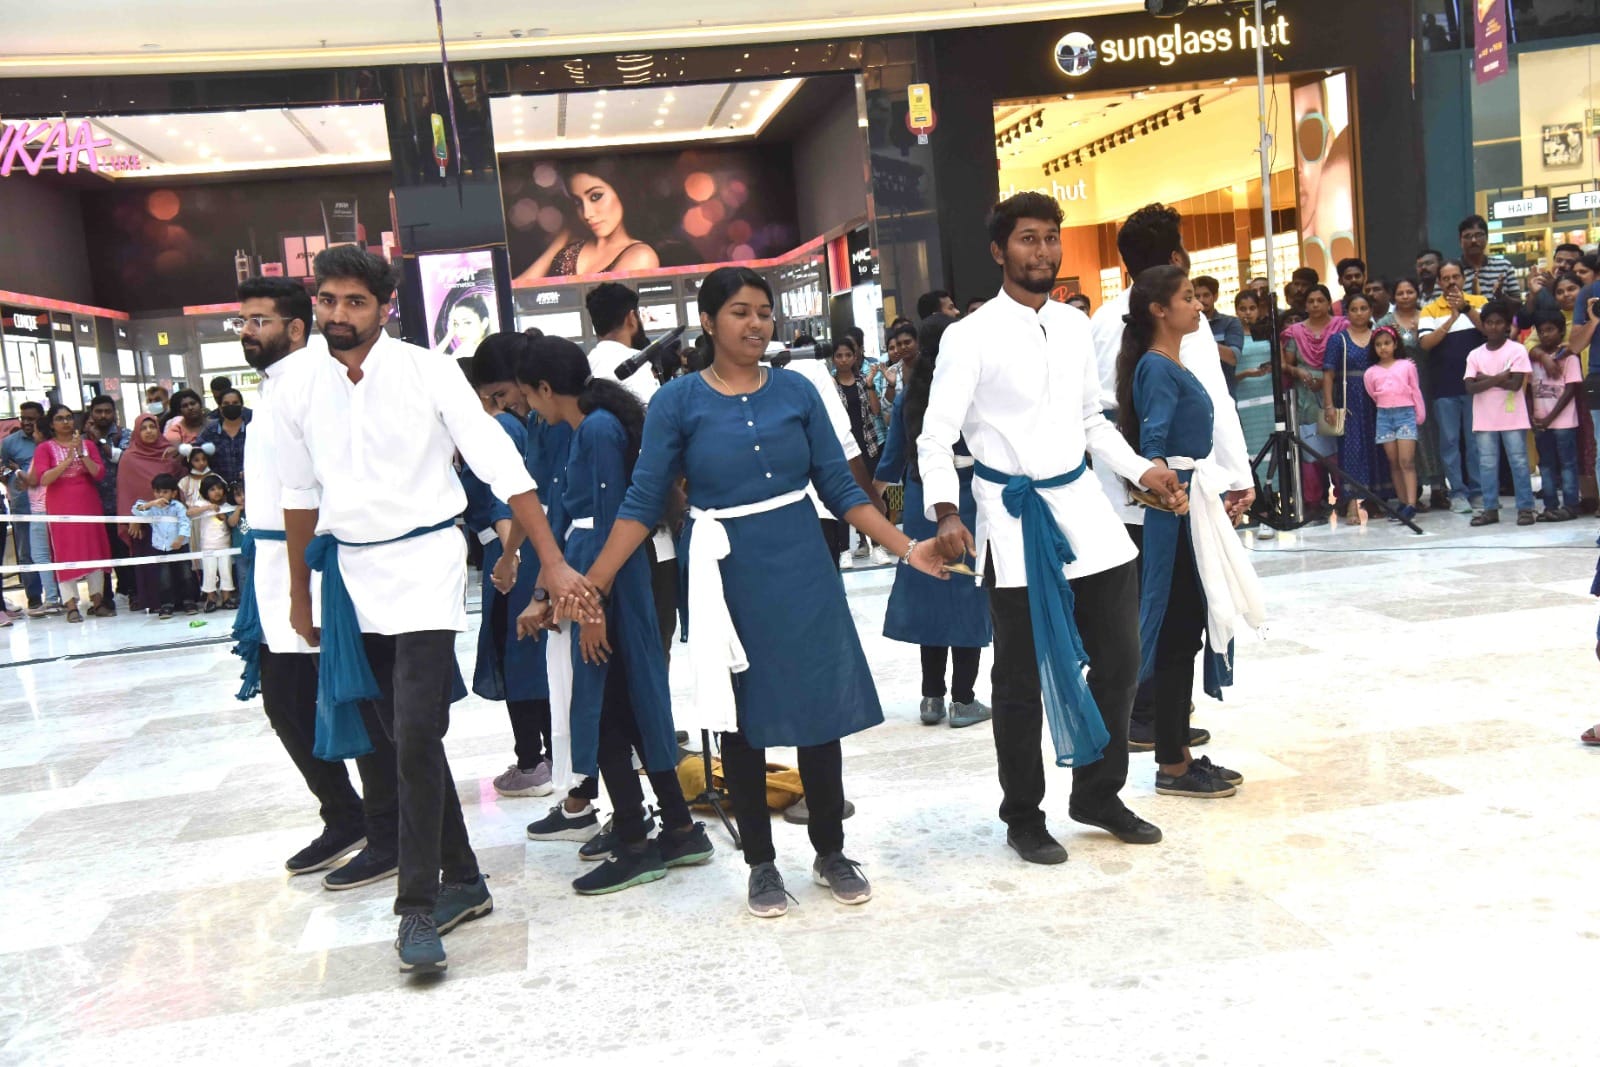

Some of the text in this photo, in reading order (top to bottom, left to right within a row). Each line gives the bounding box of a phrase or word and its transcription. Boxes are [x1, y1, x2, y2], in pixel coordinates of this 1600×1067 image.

[1100, 15, 1290, 66] sunglass hut
[1052, 179, 1087, 201] hut
[1508, 202, 1533, 214] HAIR
